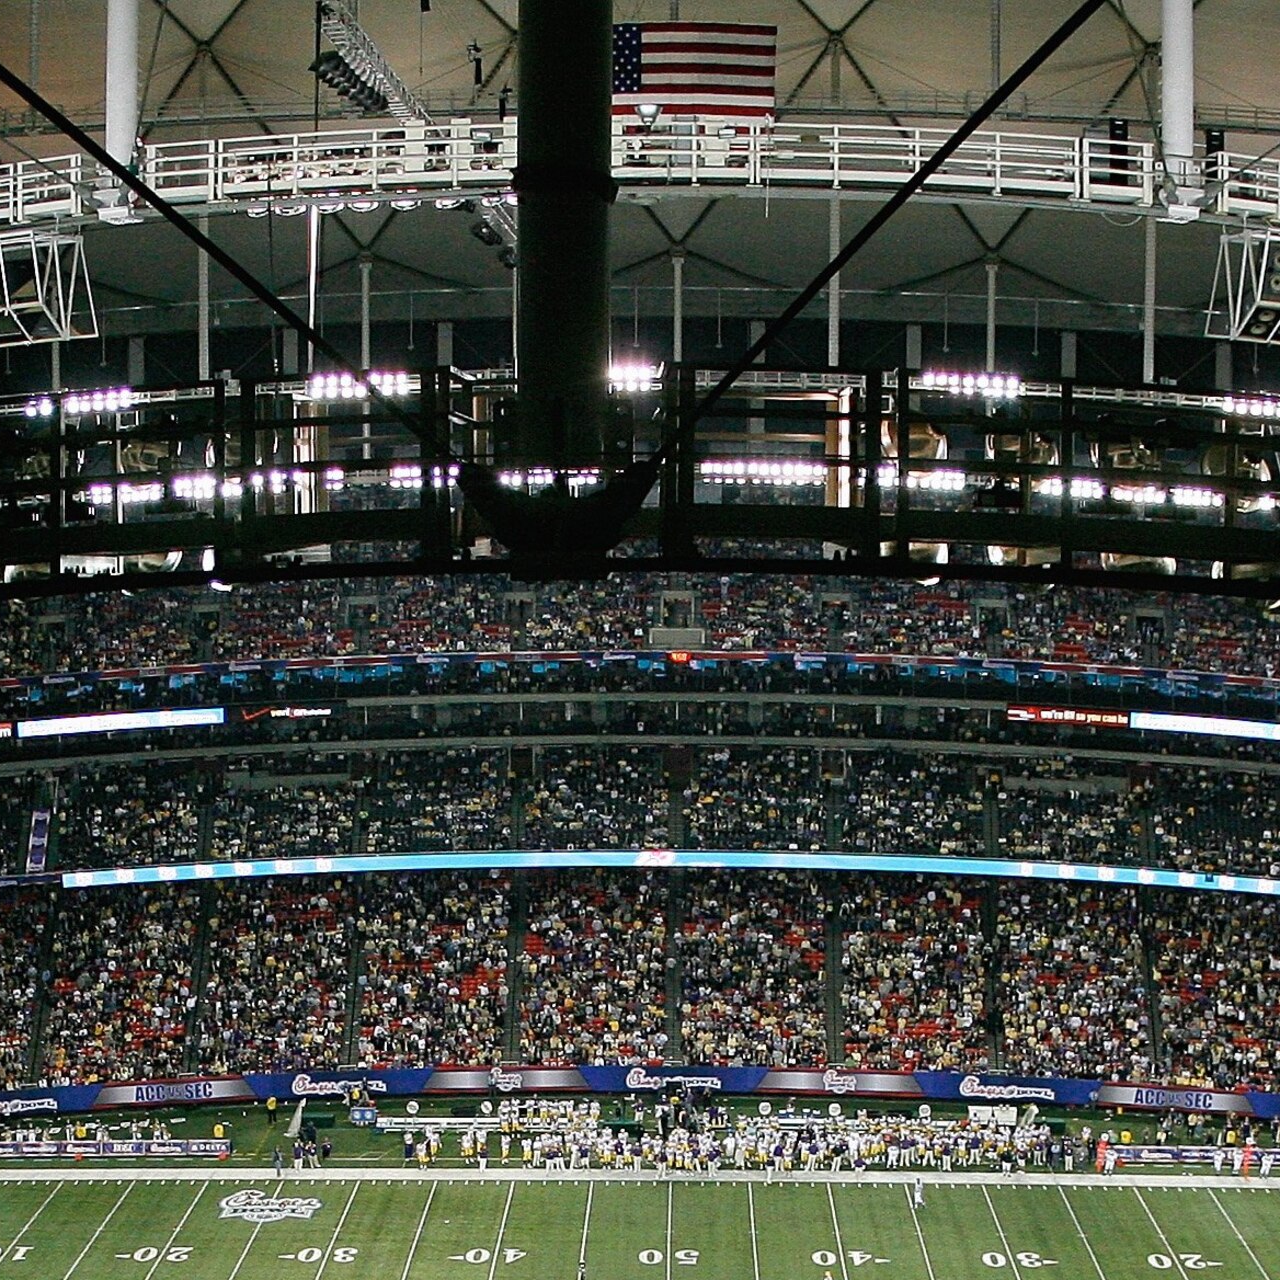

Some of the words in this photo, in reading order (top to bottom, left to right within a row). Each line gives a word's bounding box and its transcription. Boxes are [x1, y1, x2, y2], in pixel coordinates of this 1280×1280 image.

[135, 1085, 166, 1102] ACC
[185, 1082, 213, 1099] SEC
[1134, 1088, 1166, 1106] ACC
[1184, 1093, 1213, 1109] SEC
[199, 1143, 227, 1152] DELTA
[134, 1245, 195, 1262] 20
[297, 1247, 359, 1263] 30
[465, 1247, 528, 1264] 40
[638, 1249, 700, 1266] 50
[812, 1250, 874, 1267] 40
[982, 1252, 1043, 1269] 30
[1148, 1253, 1208, 1270] 20
